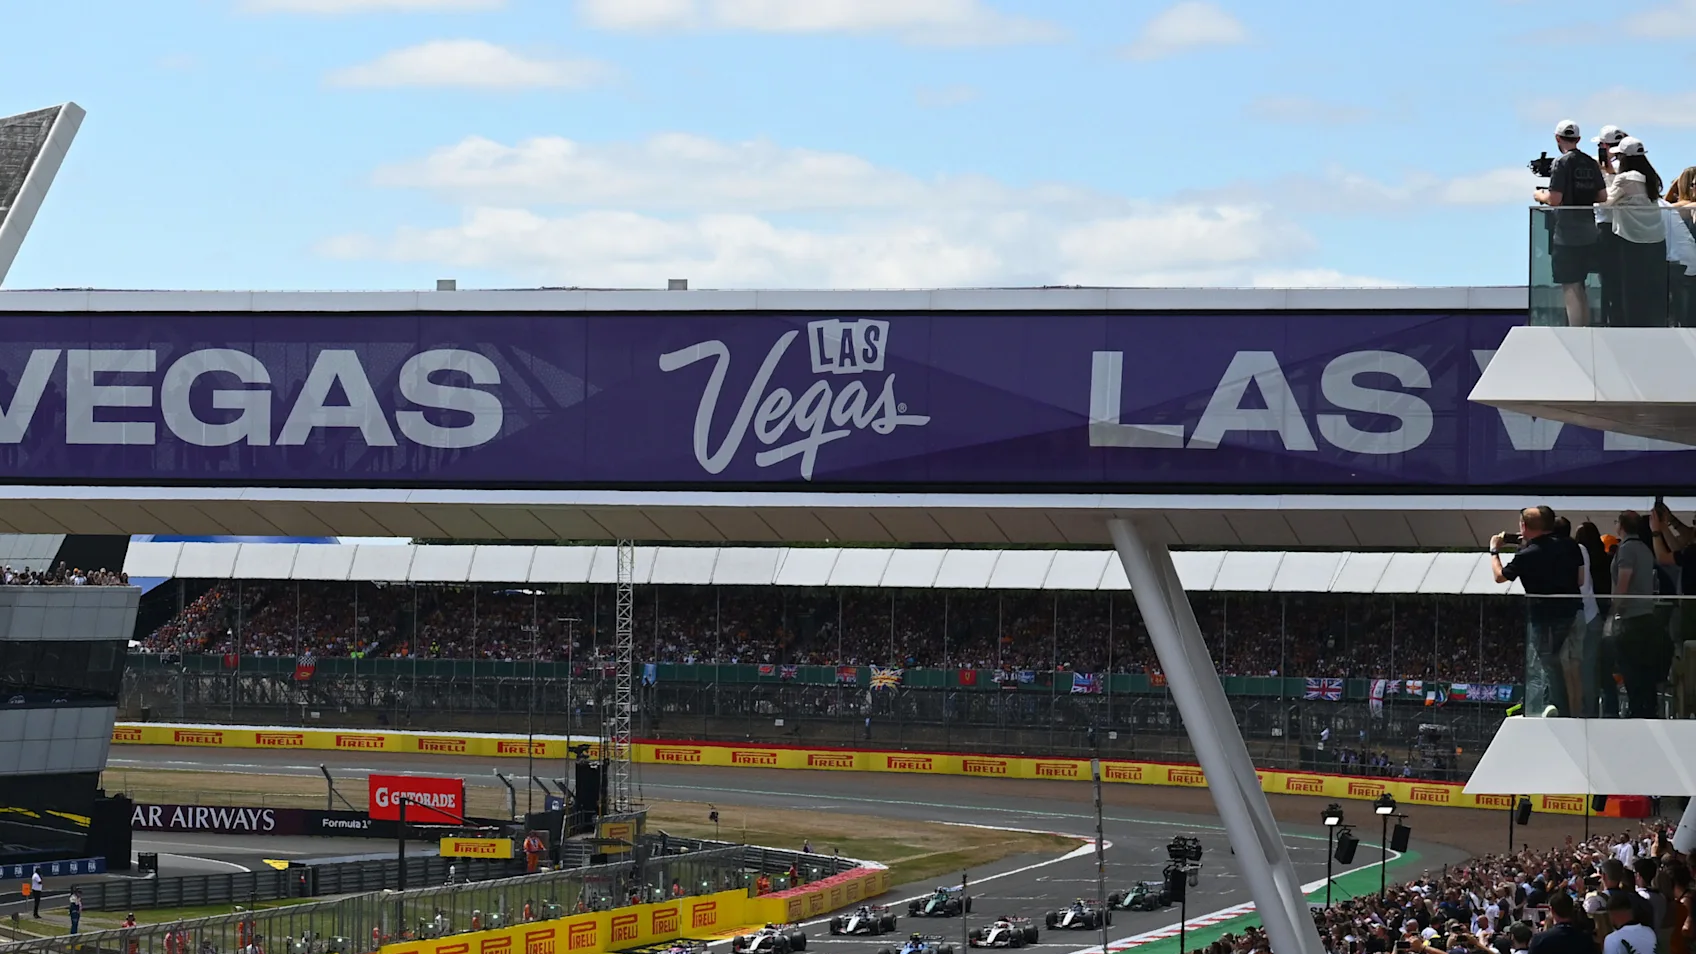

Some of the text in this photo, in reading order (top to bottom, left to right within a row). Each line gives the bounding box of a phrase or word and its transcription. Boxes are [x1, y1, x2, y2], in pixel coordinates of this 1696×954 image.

[816, 322, 880, 371] LAS
[658, 329, 931, 482] Vegas
[1088, 350, 1433, 455] LAS
[174, 731, 223, 744] PIRELLI
[256, 734, 304, 746] PIRELLI
[336, 735, 385, 748] PIRELLI
[418, 738, 466, 751] PIRELLI
[497, 741, 545, 755] PIRELLI
[655, 748, 701, 762] PIRELLI
[732, 751, 777, 764] PIRELLI
[808, 753, 854, 767] PIRELLI
[887, 755, 933, 770] PIRELLI
[963, 758, 1007, 773] PIRELLI
[1036, 762, 1078, 777] PIRELLI
[1106, 764, 1143, 779] PIRELLI
[1286, 776, 1324, 792] PIRELLI
[390, 790, 456, 809] GATORADE
[1410, 787, 1450, 802] PIRELLI
[170, 810, 275, 833] AIRWAYS
[322, 818, 355, 828] Formula
[454, 842, 496, 853] PIRELLI
[654, 909, 678, 934] PIRELLI
[694, 903, 717, 928] PIRELLI
[570, 922, 597, 951] PIRELLI
[613, 915, 639, 943] PIRELLI
